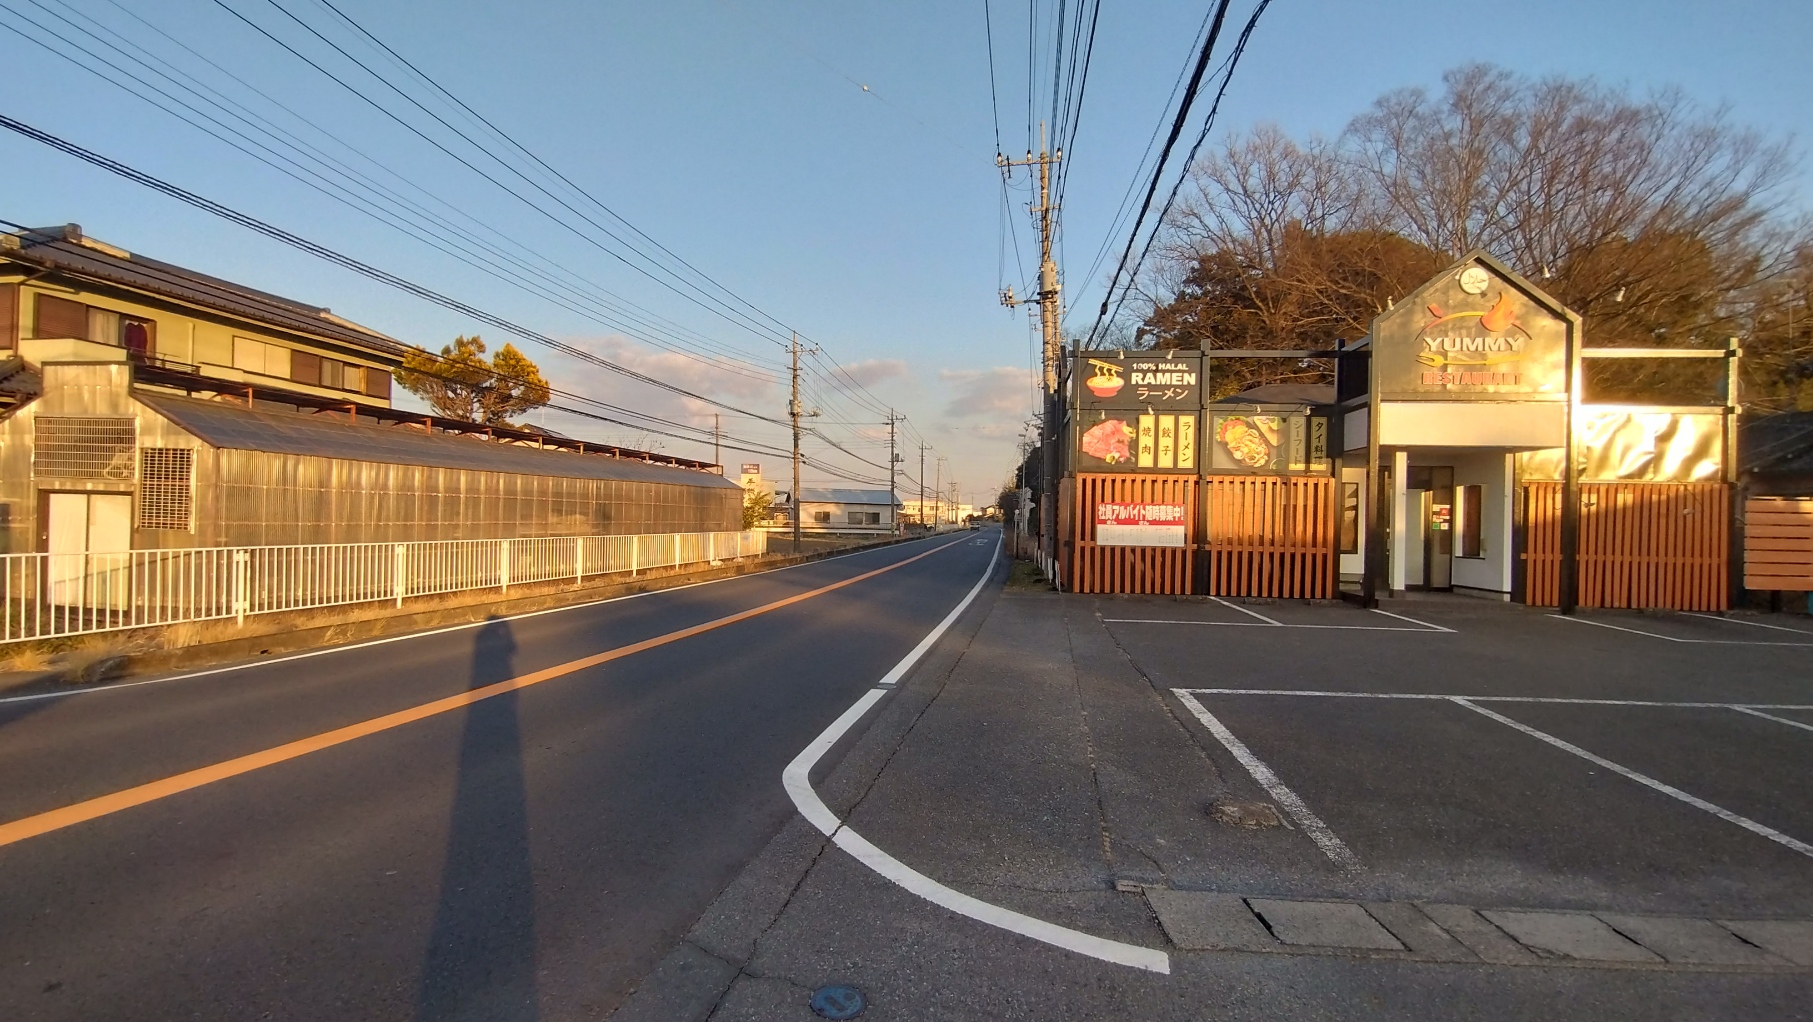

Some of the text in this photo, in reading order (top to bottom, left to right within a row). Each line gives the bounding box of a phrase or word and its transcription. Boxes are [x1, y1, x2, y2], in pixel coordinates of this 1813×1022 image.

[1423, 337, 1525, 351] YUMMY
[1132, 362, 1189, 371] 100% HALAL
[1131, 372, 1196, 385] RAMEN
[1422, 372, 1521, 385] RESTAURANT
[1136, 387, 1189, 400] ラーメン
[1141, 426, 1152, 456] 焼肉
[1161, 427, 1172, 456] 餃子
[1182, 421, 1191, 462] ラーメン
[1293, 420, 1303, 466] シーフード
